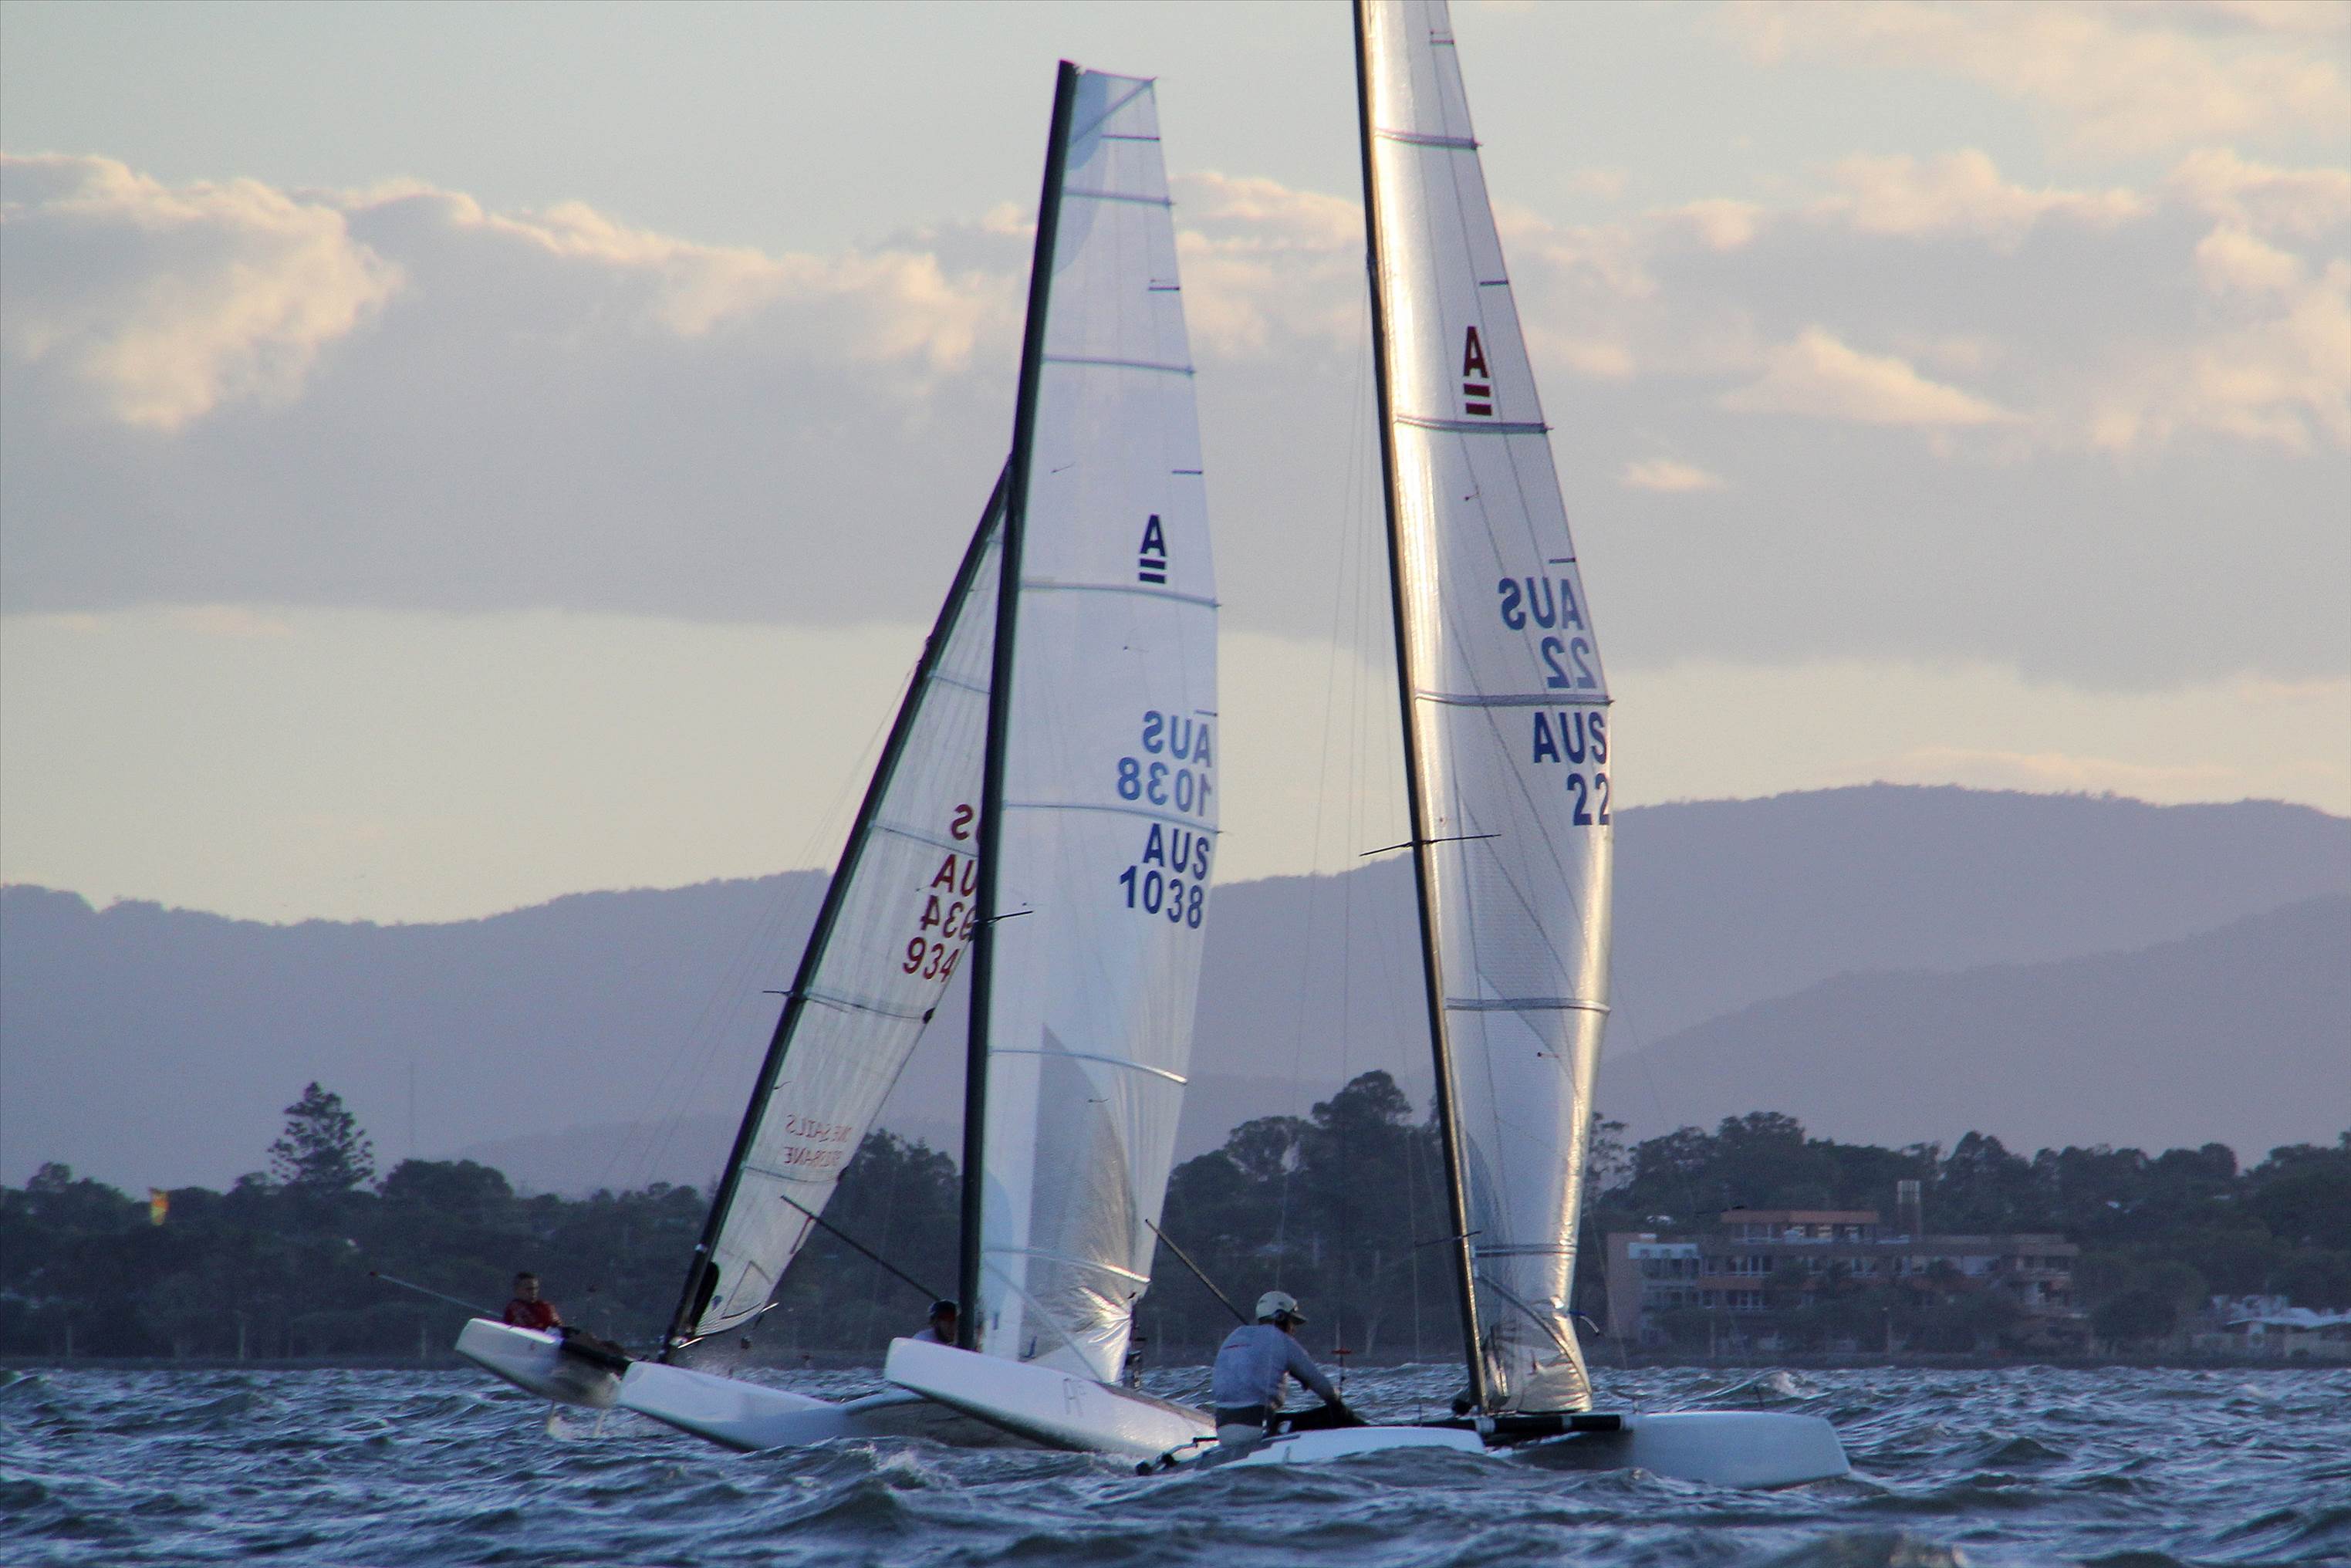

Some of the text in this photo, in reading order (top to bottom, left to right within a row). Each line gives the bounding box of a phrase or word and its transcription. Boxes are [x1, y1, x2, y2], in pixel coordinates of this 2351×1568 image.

[1463, 326, 1489, 378] A
[1140, 514, 1167, 557] A
[1533, 711, 1607, 765] AUS
[1566, 772, 1610, 826] 22
[931, 853, 977, 897] AU
[1142, 823, 1210, 881] AUS
[1119, 864, 1204, 929] 1038
[902, 936, 960, 983] 934
